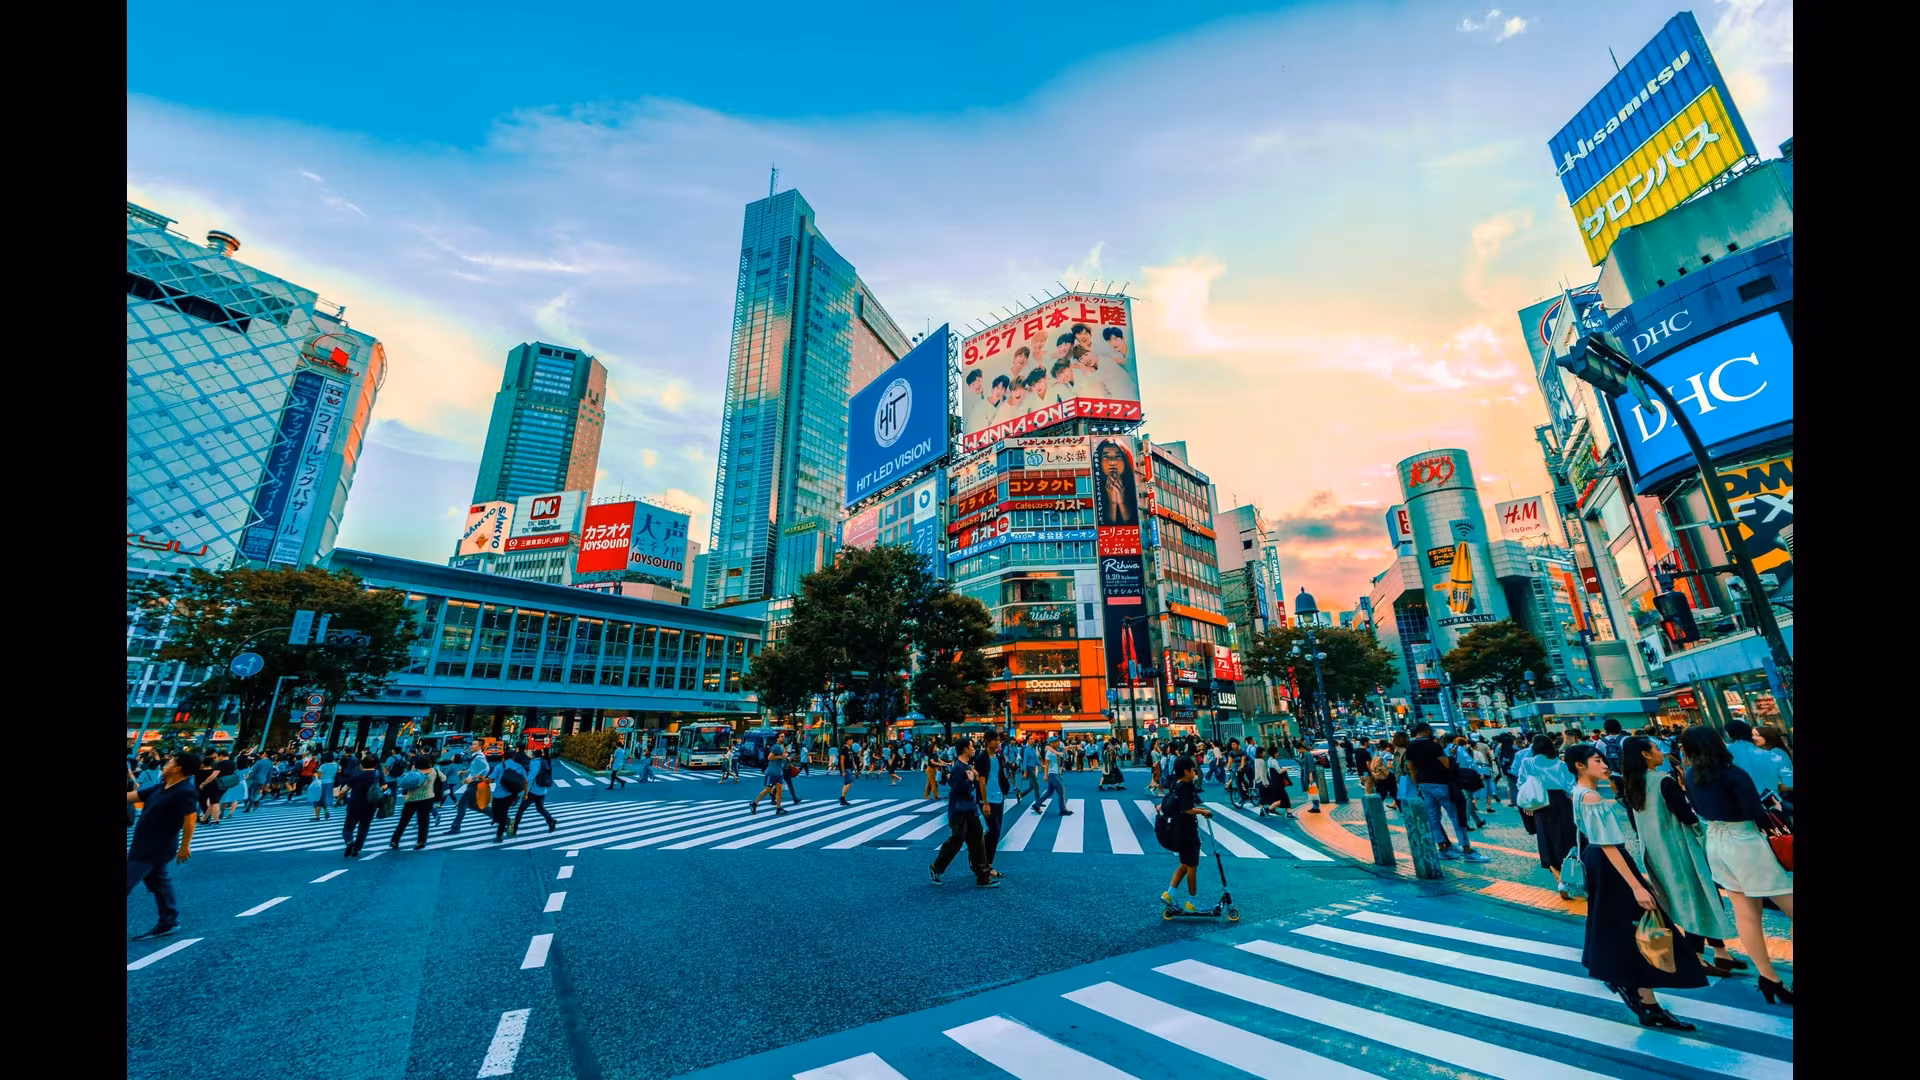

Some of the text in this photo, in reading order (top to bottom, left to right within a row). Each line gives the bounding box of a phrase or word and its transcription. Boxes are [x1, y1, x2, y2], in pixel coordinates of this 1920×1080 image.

[1556, 49, 1691, 177] Hisamitsu
[1581, 120, 1720, 240] サロンパス
[964, 303, 1127, 366] 9.27 日本上陸
[1632, 309, 1692, 356] DHC
[1631, 352, 1768, 443] DHC
[1079, 401, 1138, 416] ワナワン
[1016, 436, 1085, 446] しゃぶしゃぶバイキング
[282, 411, 332, 535] ワコールビッグバザール
[856, 472, 873, 493] HIT
[873, 461, 893, 483] LED
[894, 437, 932, 470] VISION
[1409, 461, 1455, 487] 109
[1010, 480, 1074, 493] コンタクト
[980, 507, 1000, 522] ガスト
[1055, 499, 1086, 511] ガスト
[1504, 500, 1537, 524] H&M
[464, 508, 496, 539] SANKYO
[491, 506, 508, 548] SANKYO
[584, 522, 630, 540] カラオケ
[635, 513, 687, 542] 大声
[1099, 527, 1139, 538] ユリゴコロ
[582, 538, 629, 551] JOYSOUND
[971, 525, 995, 545] ガスト
[1038, 531, 1095, 540] 英会話イーオン
[629, 552, 683, 571] JOYSOUND
[1102, 558, 1140, 573] Rihwa
[1105, 573, 1121, 581] 9.20
[1025, 680, 1071, 688] L'OCCITANE
[1218, 692, 1237, 705] LUSH
